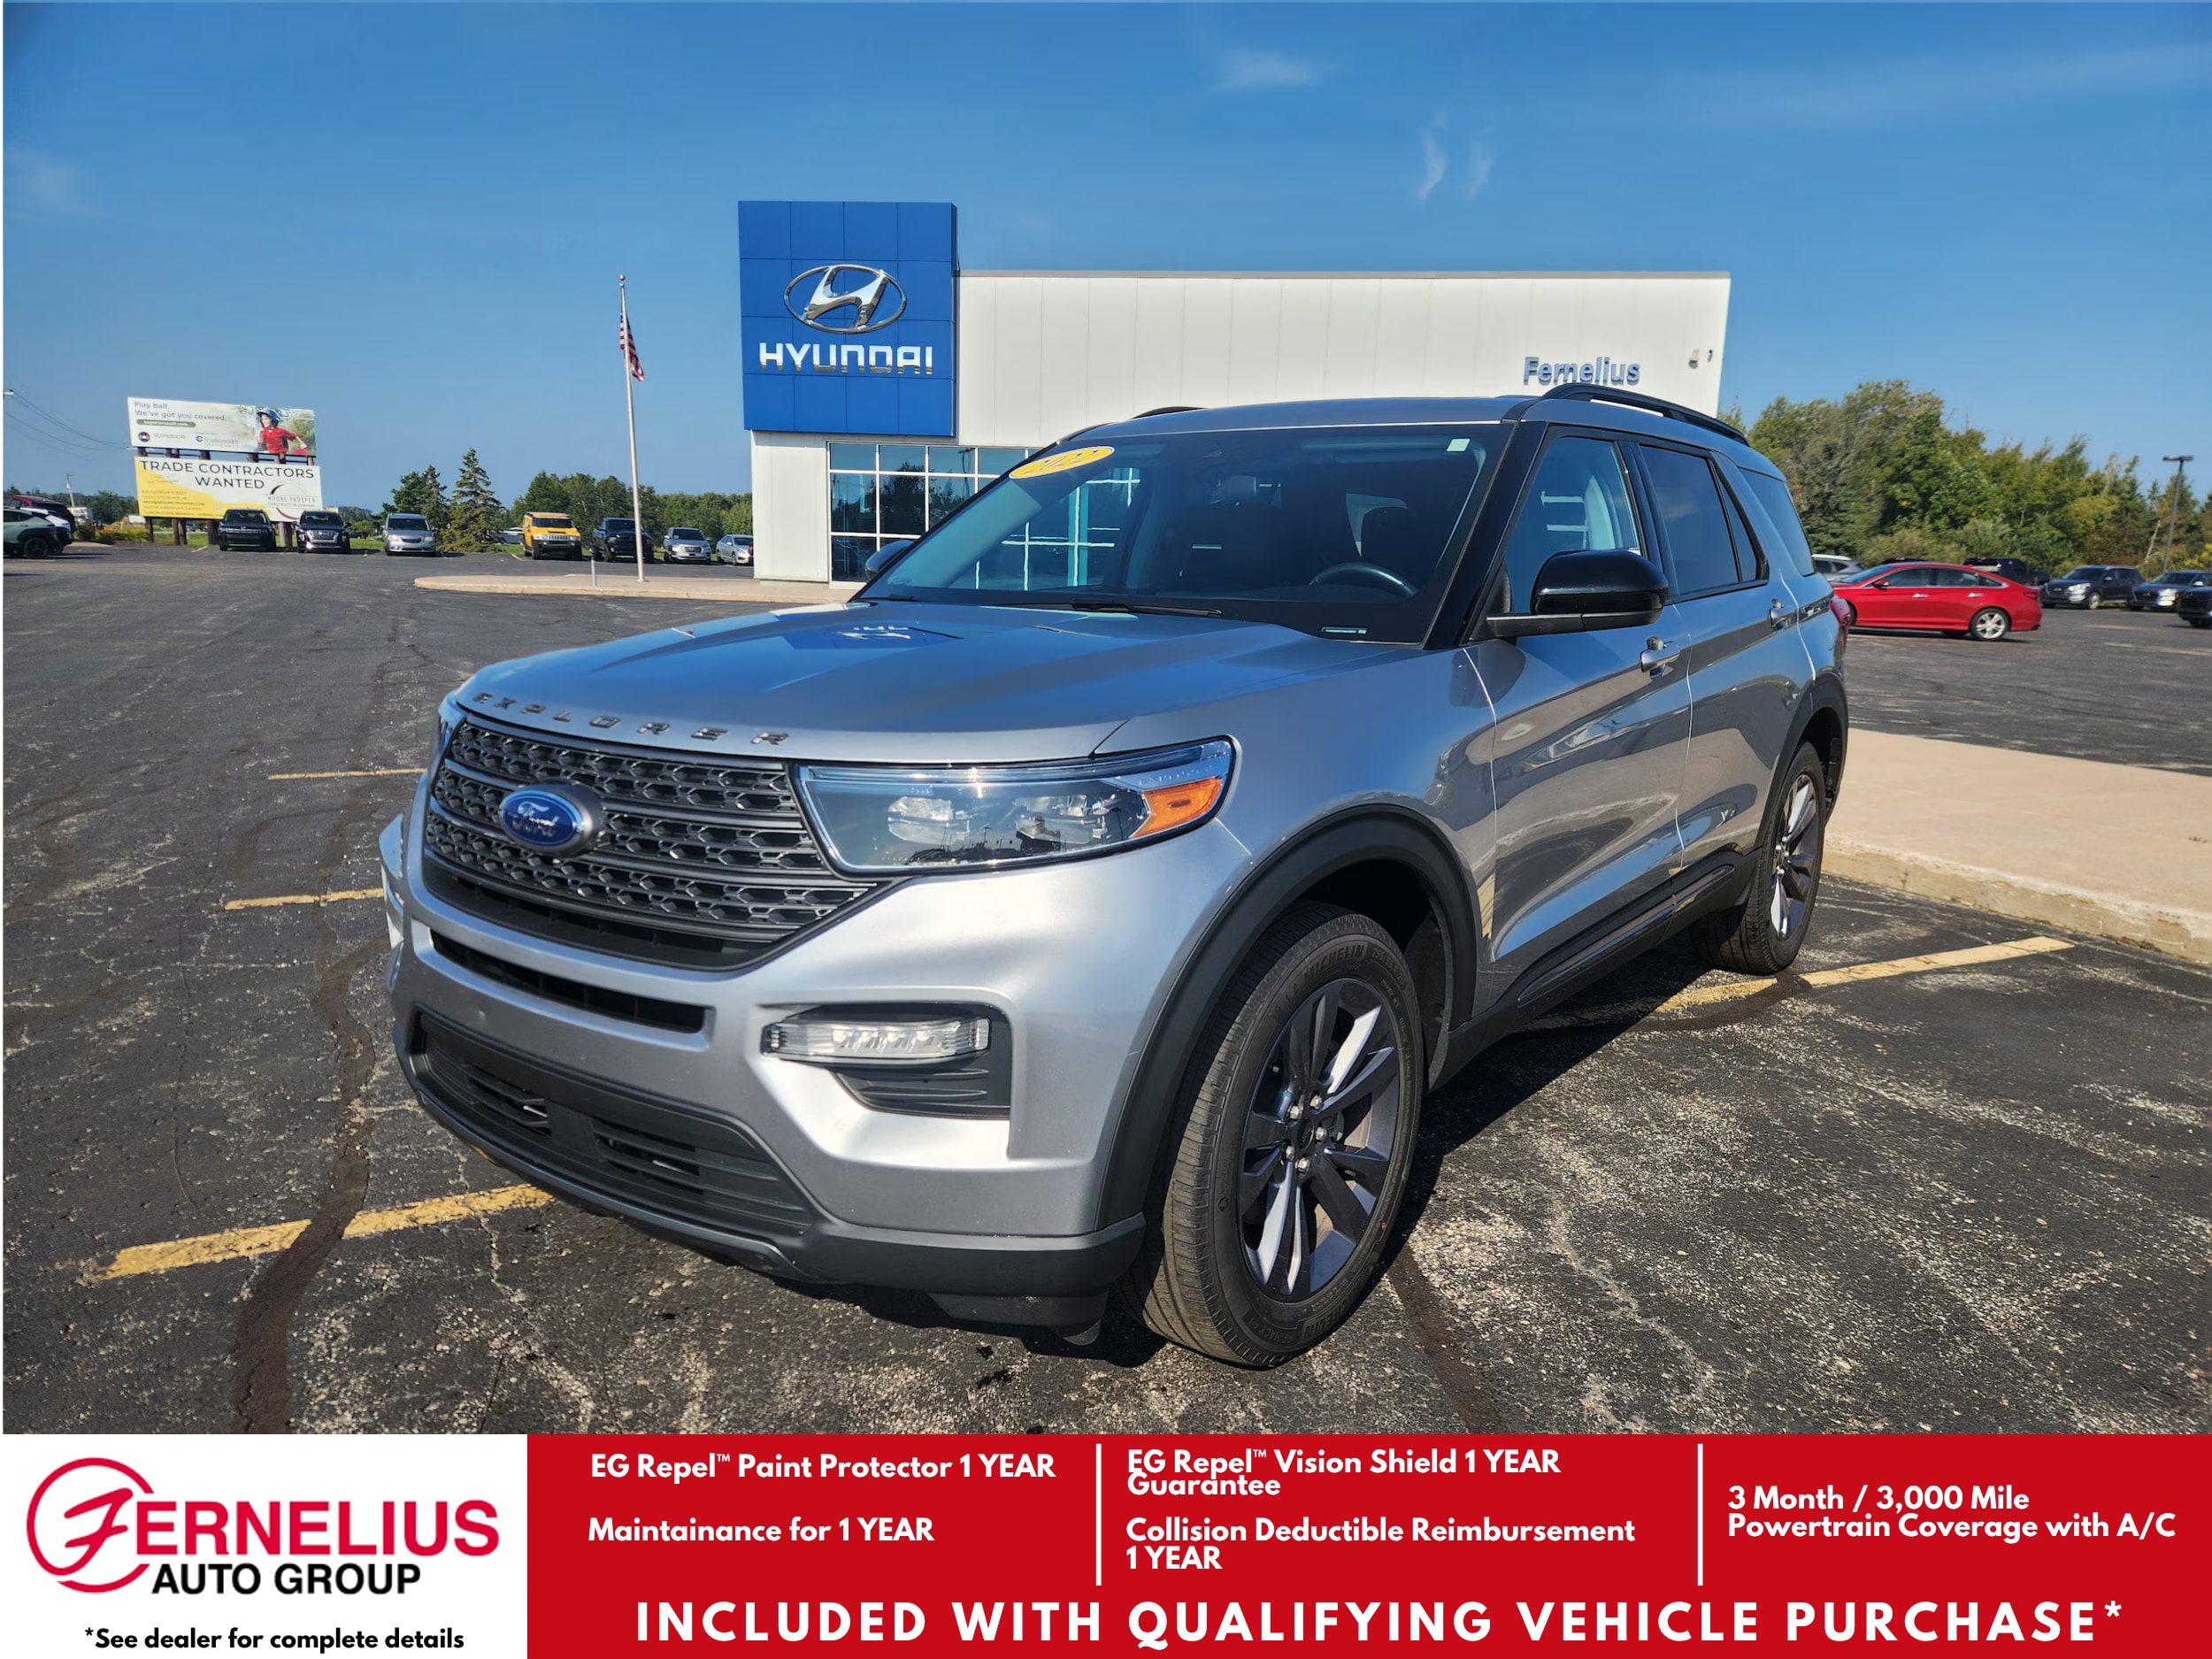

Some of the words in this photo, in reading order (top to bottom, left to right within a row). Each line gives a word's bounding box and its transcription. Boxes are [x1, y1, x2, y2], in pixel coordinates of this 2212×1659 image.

[758, 342, 933, 375] HYUNDAI
[1524, 357, 1640, 386] Fernelius
[140, 460, 194, 472] TRADE
[198, 463, 314, 479] CONTRACTORS
[195, 476, 265, 489] WANTED
[472, 692, 789, 746] EXPLORER
[1303, 944, 1364, 984] MICHELIN
